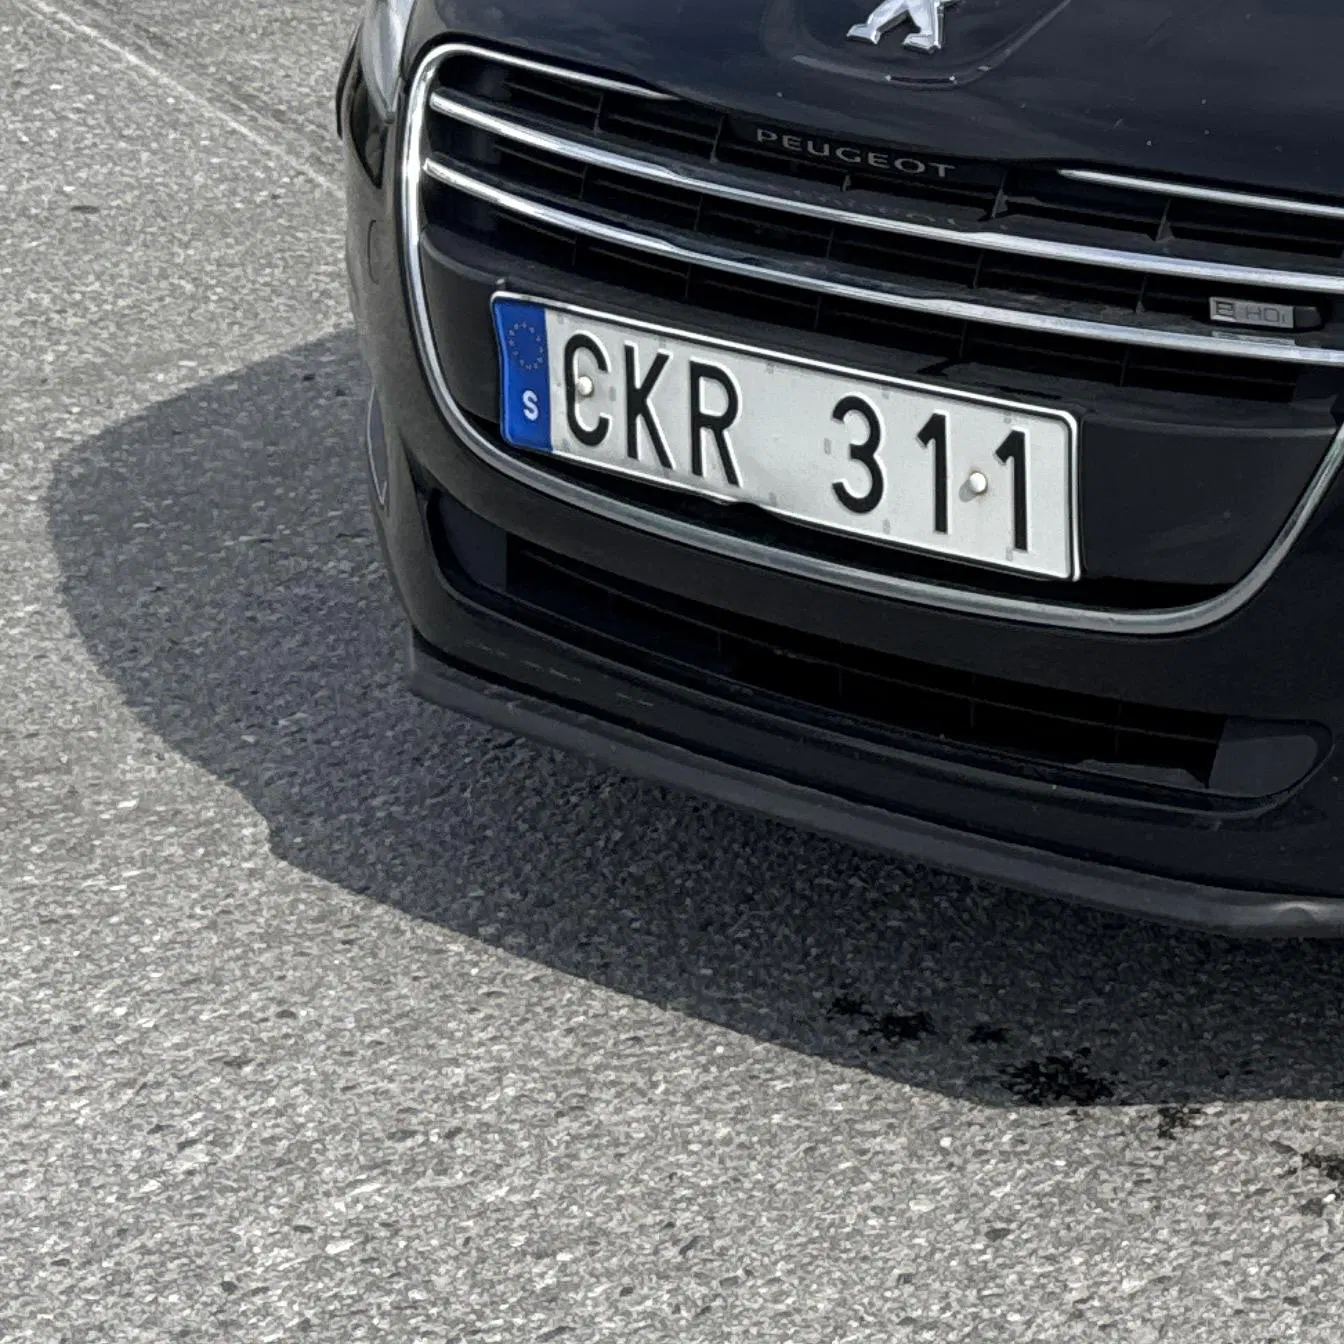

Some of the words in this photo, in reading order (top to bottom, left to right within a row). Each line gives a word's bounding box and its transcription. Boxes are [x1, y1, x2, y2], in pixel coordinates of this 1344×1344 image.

[756, 128, 956, 178] PEUGEOT
[521, 389, 539, 422] S
[564, 332, 741, 488] CKR
[831, 394, 1031, 552] 311
